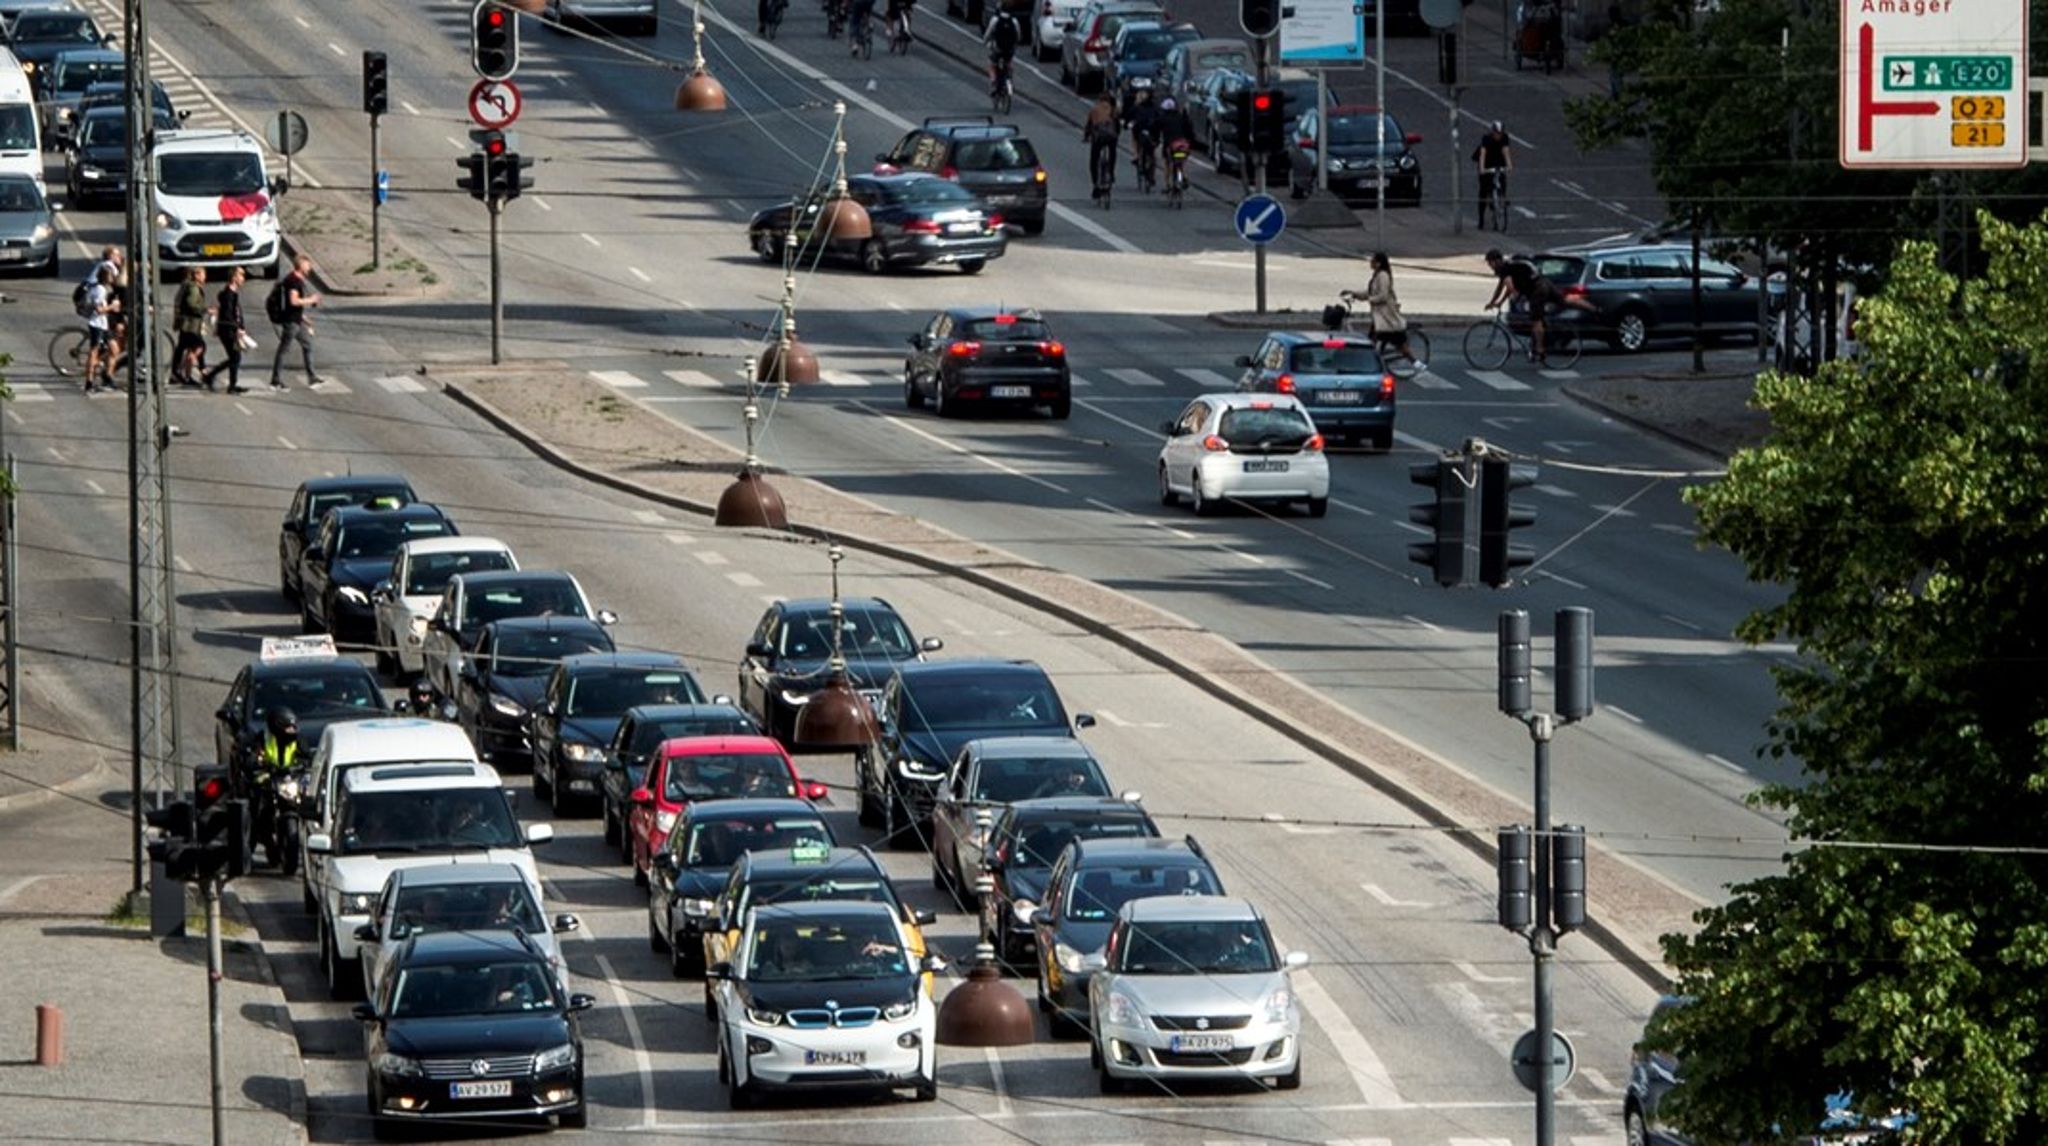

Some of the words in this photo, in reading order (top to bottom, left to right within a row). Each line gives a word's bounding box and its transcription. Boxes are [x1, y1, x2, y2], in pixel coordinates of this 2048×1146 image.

[1860, 0, 1950, 16] Amager
[1957, 66, 1999, 81] E20
[1967, 127, 1988, 142] 21
